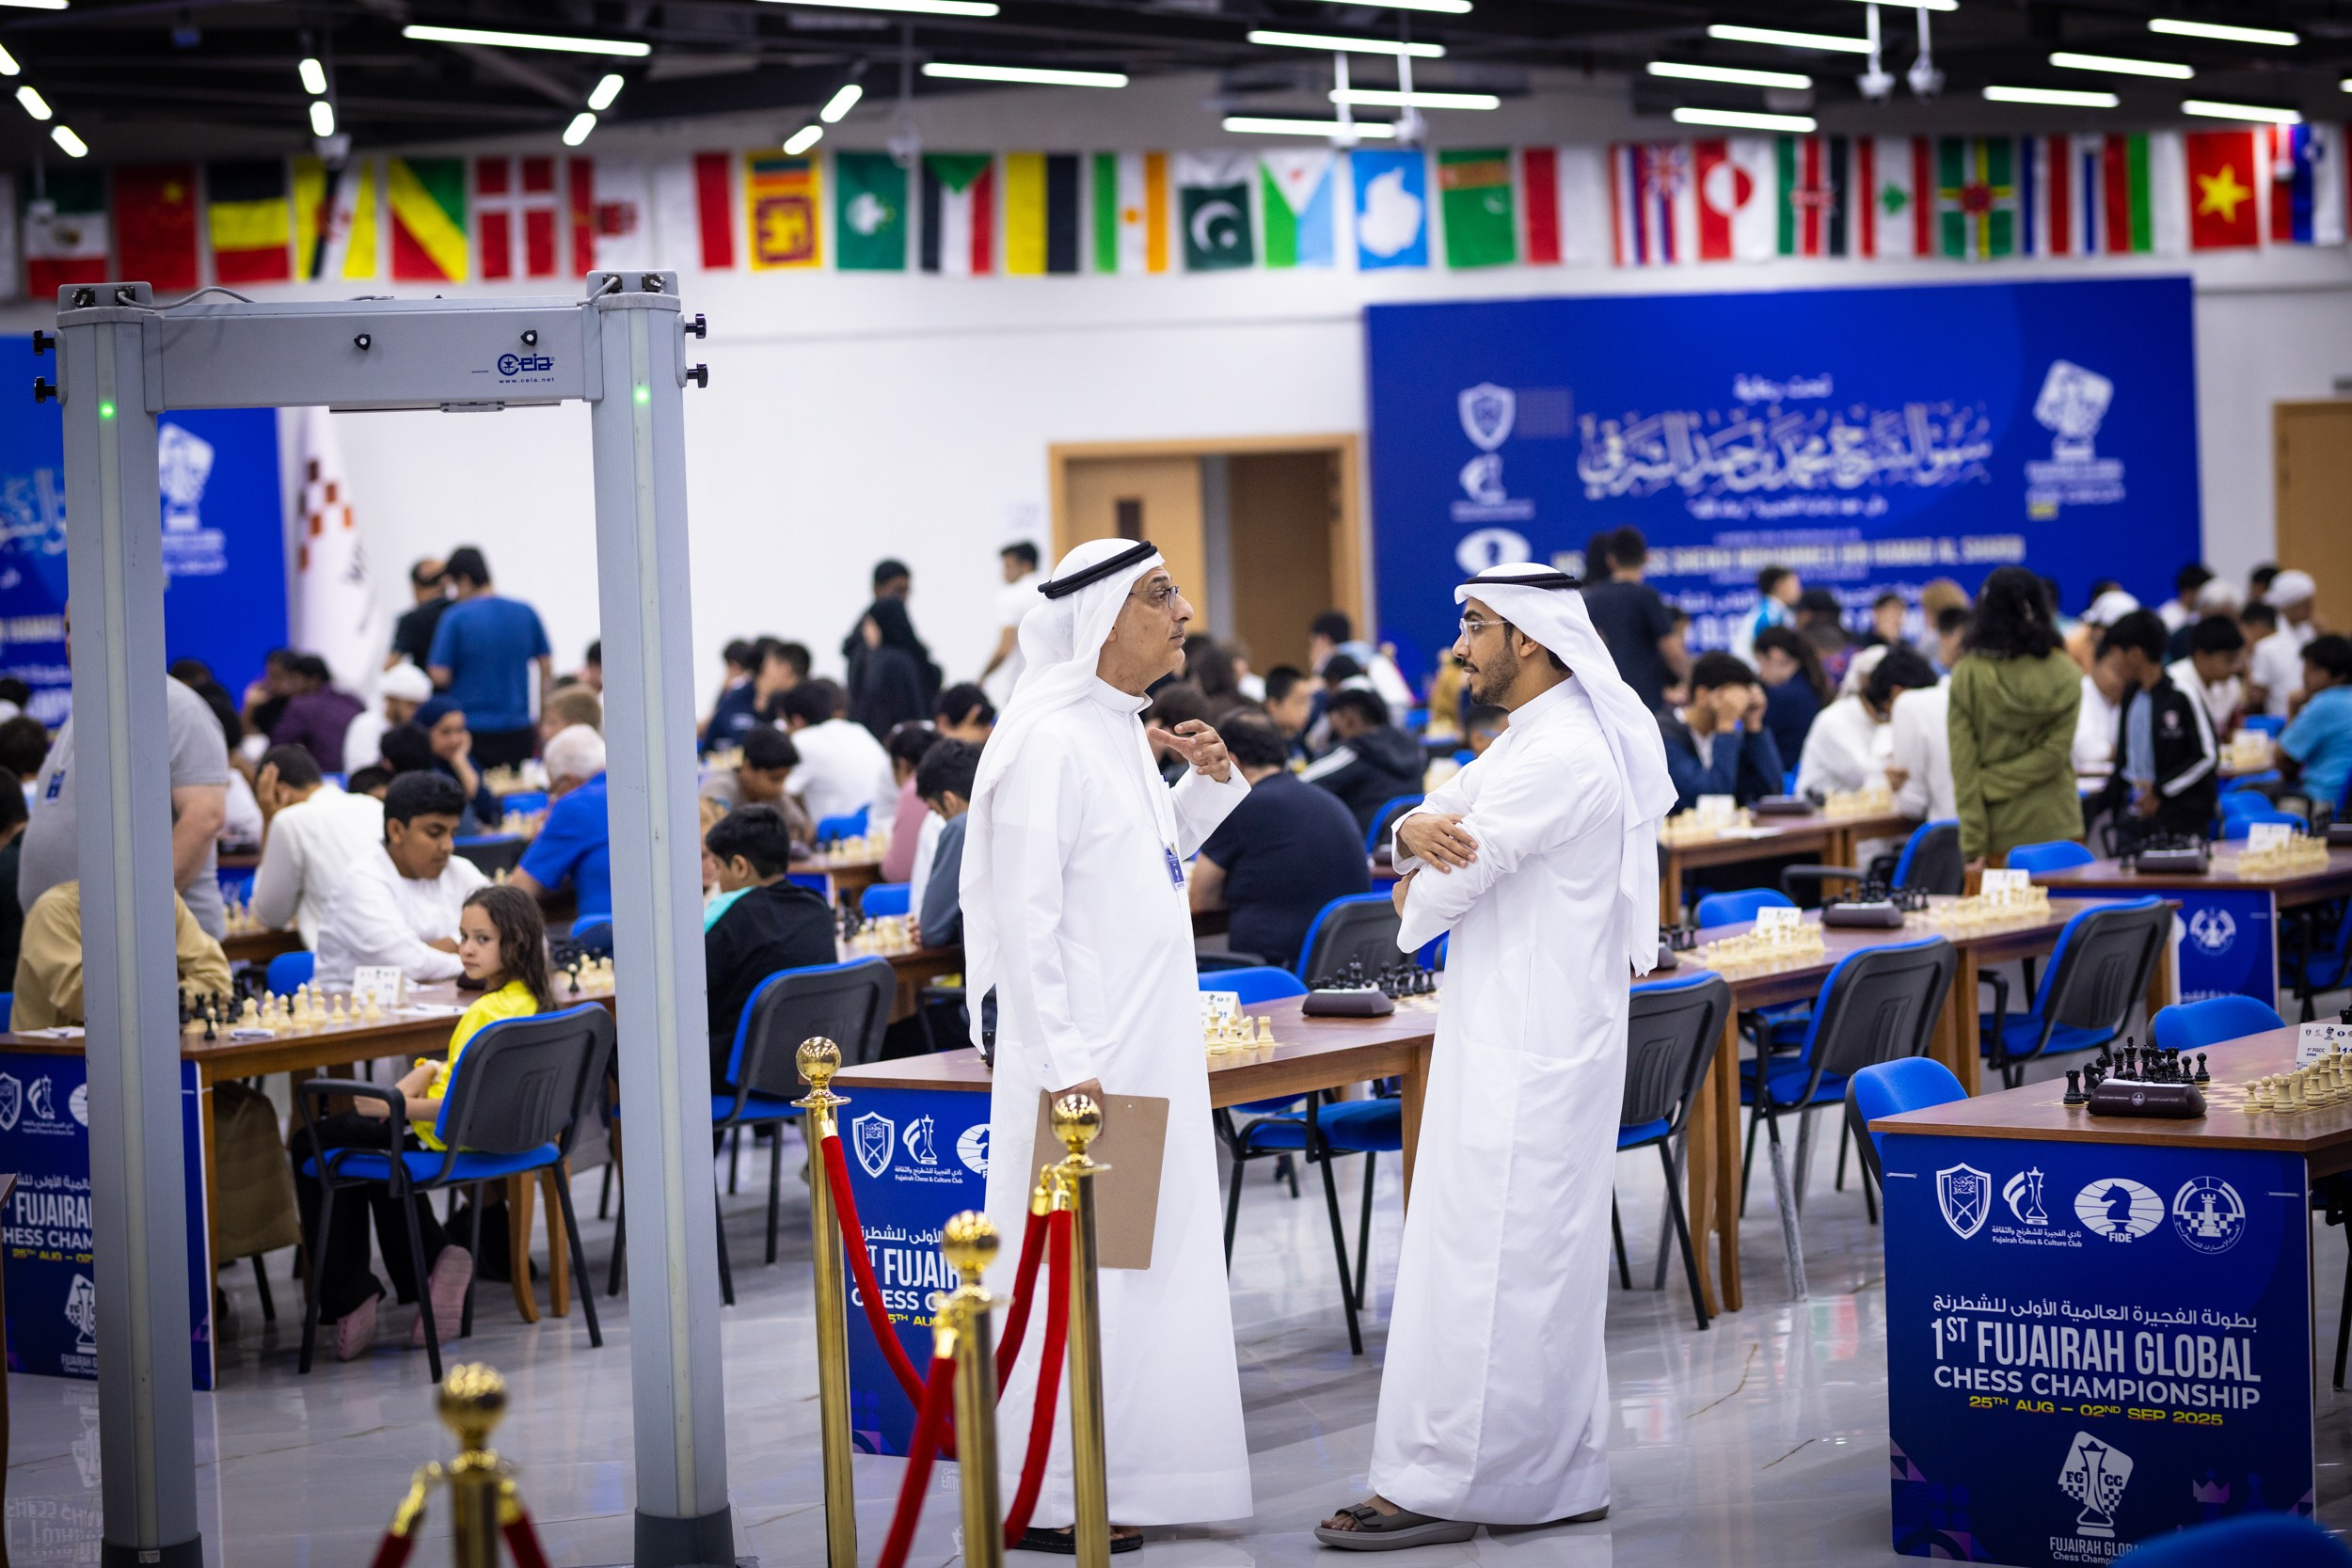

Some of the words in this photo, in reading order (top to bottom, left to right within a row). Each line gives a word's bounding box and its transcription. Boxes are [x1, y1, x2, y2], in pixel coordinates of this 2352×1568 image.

[895, 1174, 914, 1182] Fujairah
[3, 1226, 44, 1246] HESS
[1992, 1236, 2017, 1245] Fujairah
[2043, 1239, 2067, 1247] Culture
[2067, 1240, 2083, 1248] Club
[2016, 1227, 2043, 1238] للشطرنج
[2043, 1228, 2067, 1239] الفجيرة
[2108, 1231, 2133, 1243] FIDE
[850, 1287, 920, 1311] CESS
[1932, 1292, 2007, 1313] للشطرنج
[2010, 1298, 2058, 1319] الأولى
[887, 1313, 909, 1325] 5TH
[2060, 1299, 2129, 1323] العالمية
[2132, 1305, 2198, 1328] الفجيرة
[2201, 1307, 2258, 1334] بطولة
[1931, 1316, 1969, 1360] 1ST
[1977, 1321, 2125, 1373] FUJAIRAH
[2135, 1331, 2262, 1383] GLOBAL
[1933, 1365, 2024, 1394] CHESS
[2030, 1372, 2261, 1410] CHAMPIONSHIP
[1968, 1395, 2010, 1409] 25TH
[2015, 1399, 2055, 1414] AUG
[2079, 1404, 2122, 1418] 02ND
[2126, 1407, 2167, 1421] SEP
[2171, 1411, 2224, 1427] 2025
[2065, 1470, 2085, 1484] FG
[2104, 1474, 2123, 1487] CC
[2049, 1536, 2102, 1556] FUJAIRAH
[2052, 1550, 2080, 1562] Chess
